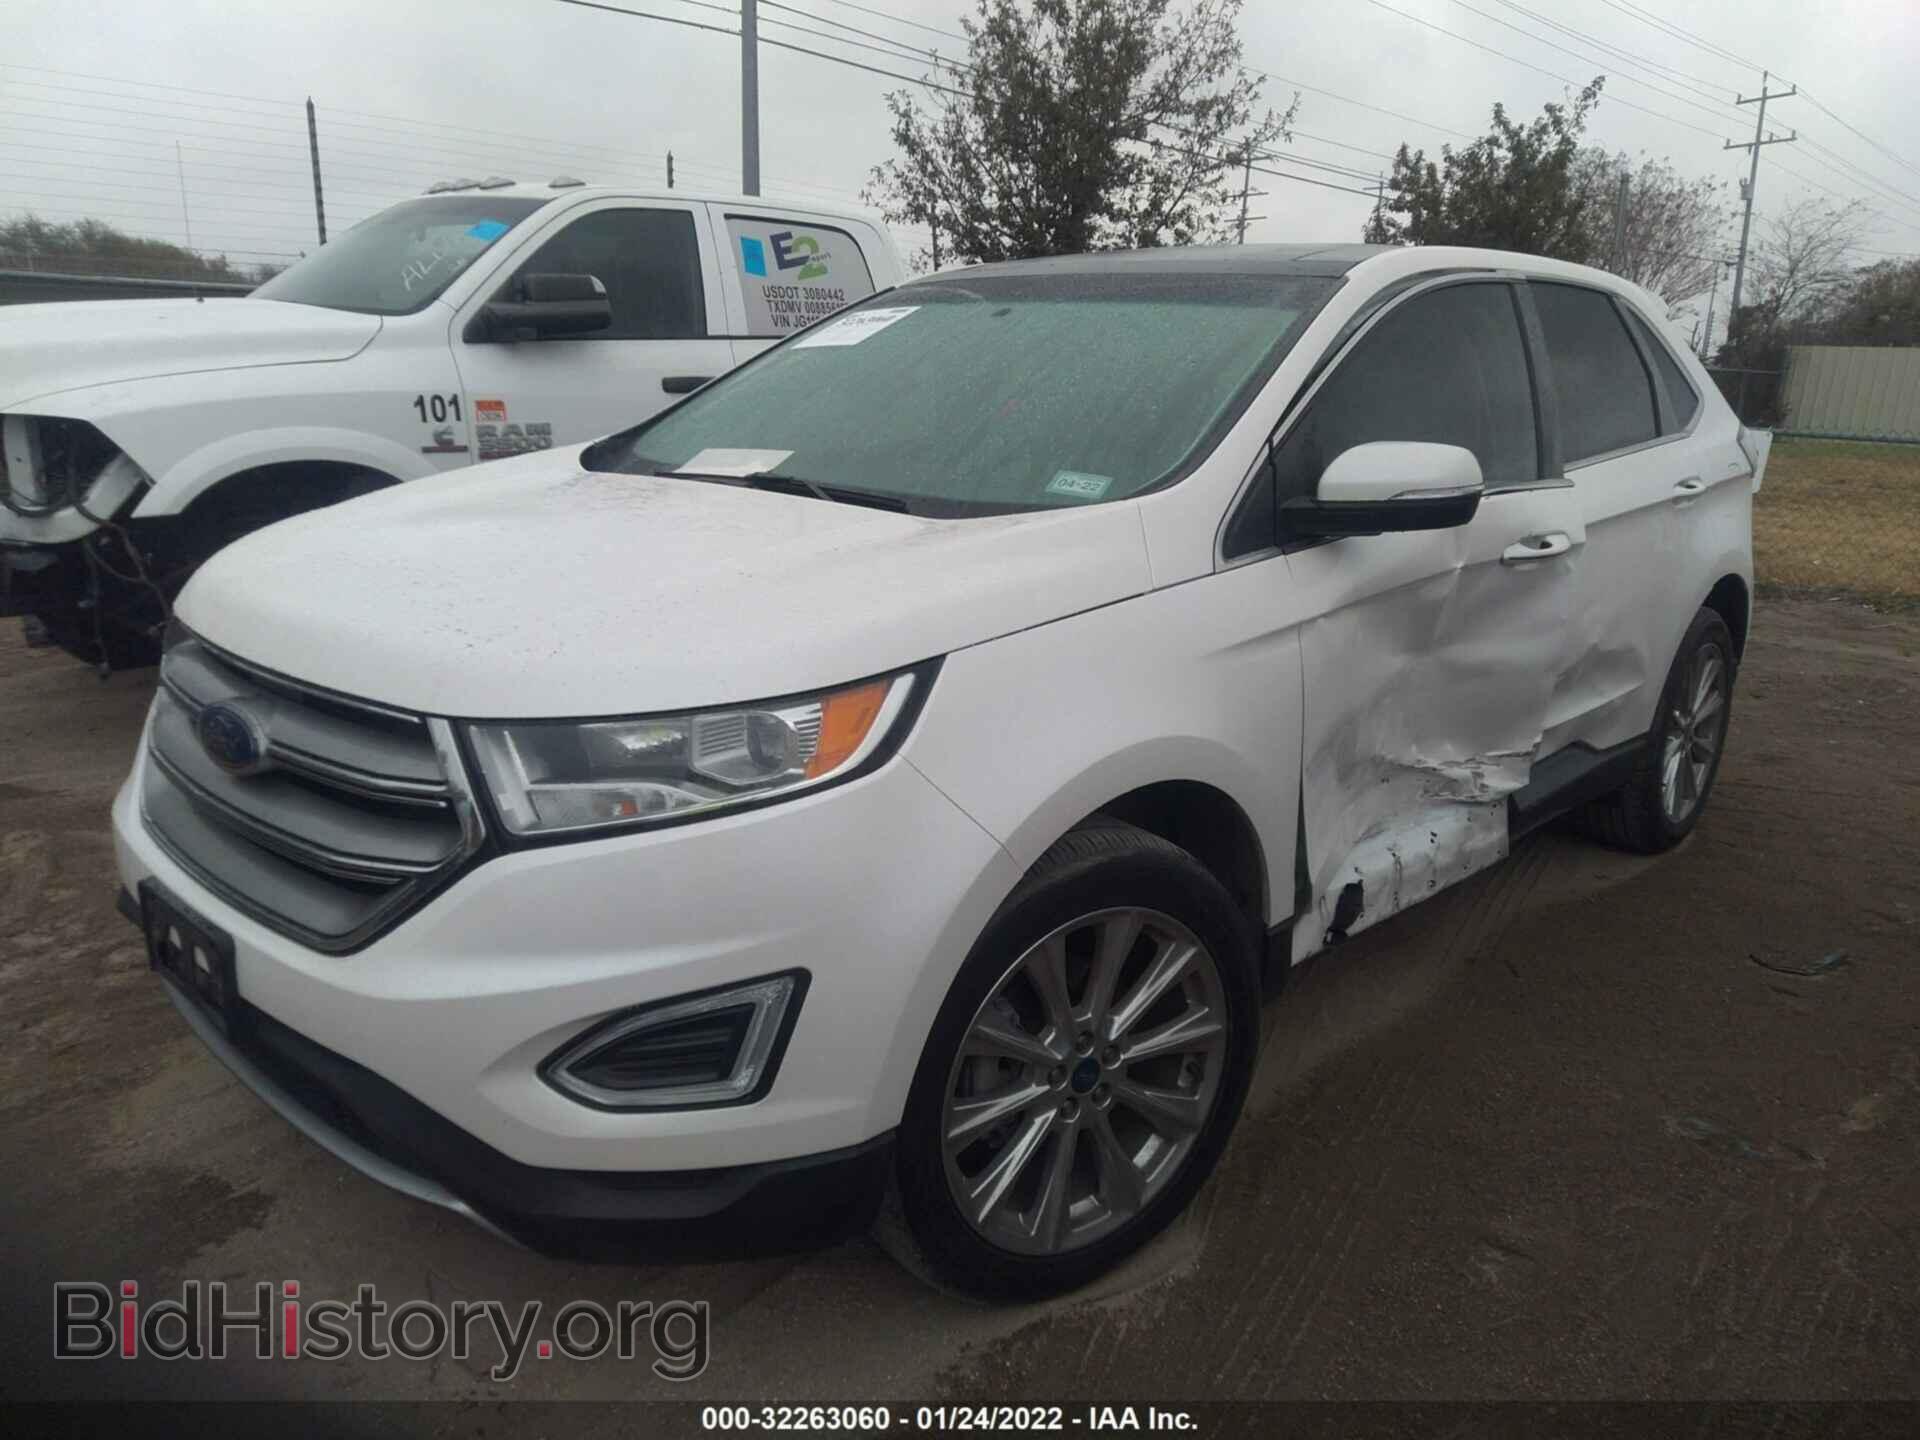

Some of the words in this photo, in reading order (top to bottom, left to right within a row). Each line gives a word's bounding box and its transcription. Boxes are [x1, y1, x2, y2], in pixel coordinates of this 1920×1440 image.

[762, 285, 800, 299] USDOT
[771, 314, 790, 328] VIN
[414, 394, 461, 423] 101
